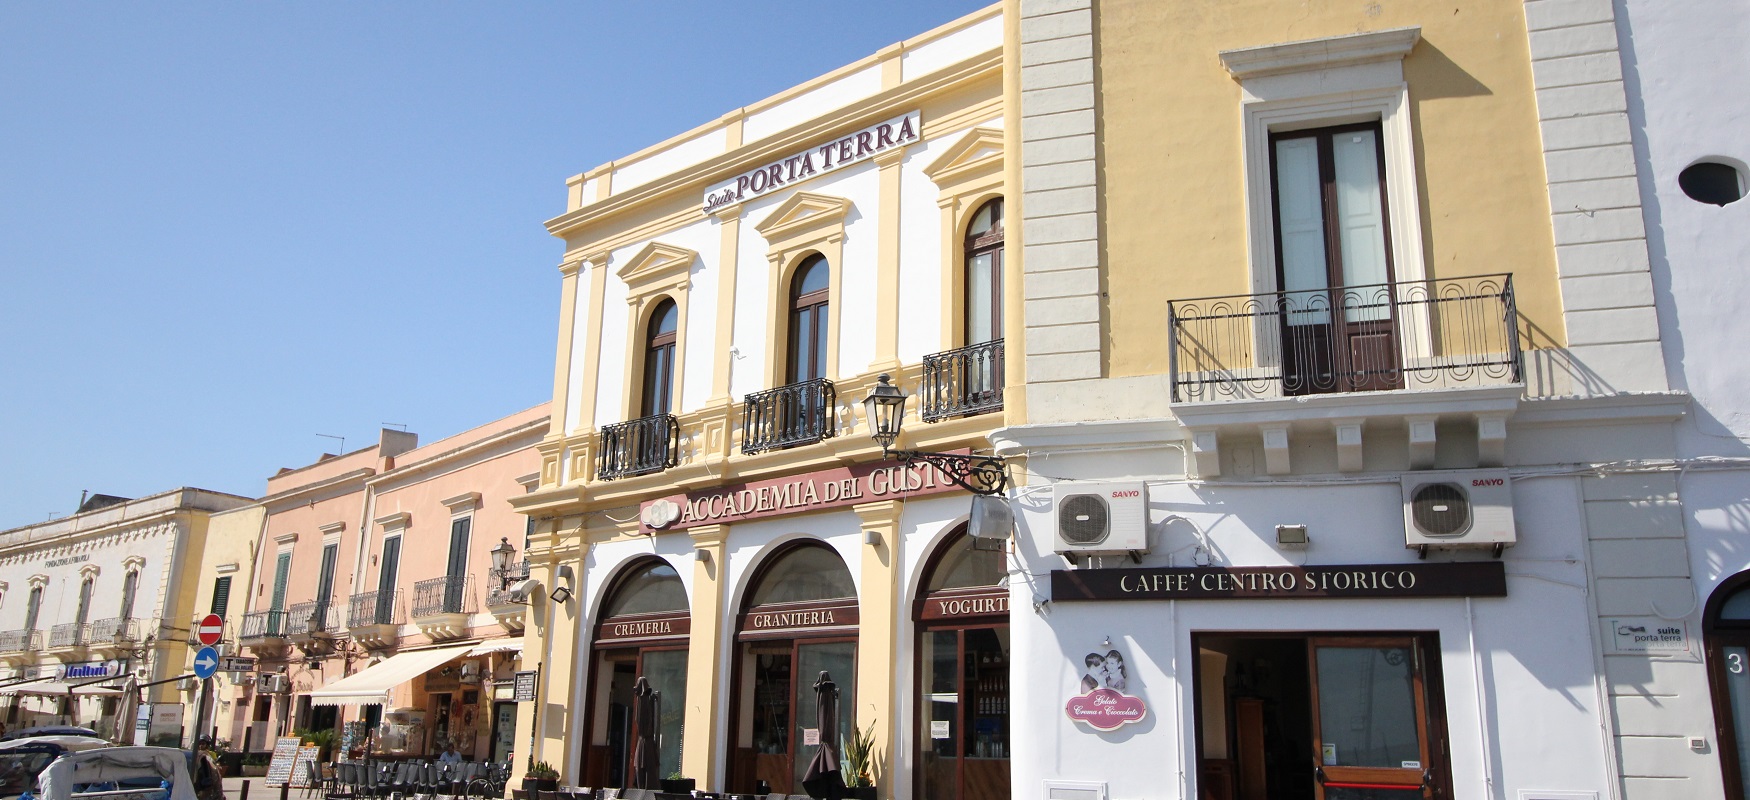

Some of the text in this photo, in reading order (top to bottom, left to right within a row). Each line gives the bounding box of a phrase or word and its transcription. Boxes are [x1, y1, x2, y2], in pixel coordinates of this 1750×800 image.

[703, 115, 916, 213] Suite PORTA TERRA
[1472, 478, 1504, 487] SANYO
[681, 481, 821, 524] ACCADEMIA
[823, 477, 863, 503] DEL
[1112, 490, 1139, 498] SANYO
[1200, 572, 1296, 592] CENTRO
[1305, 570, 1416, 590] STORICO
[754, 610, 835, 628] GRANITERIA
[614, 621, 672, 636] CREMERIA
[1657, 626, 1681, 635] suite
[1634, 635, 1659, 643] porta
[1727, 653, 1743, 674] 3
[1093, 695, 1117, 707] Gelato
[1074, 705, 1098, 715] Crema
[1104, 706, 1139, 716] Cioccolato
